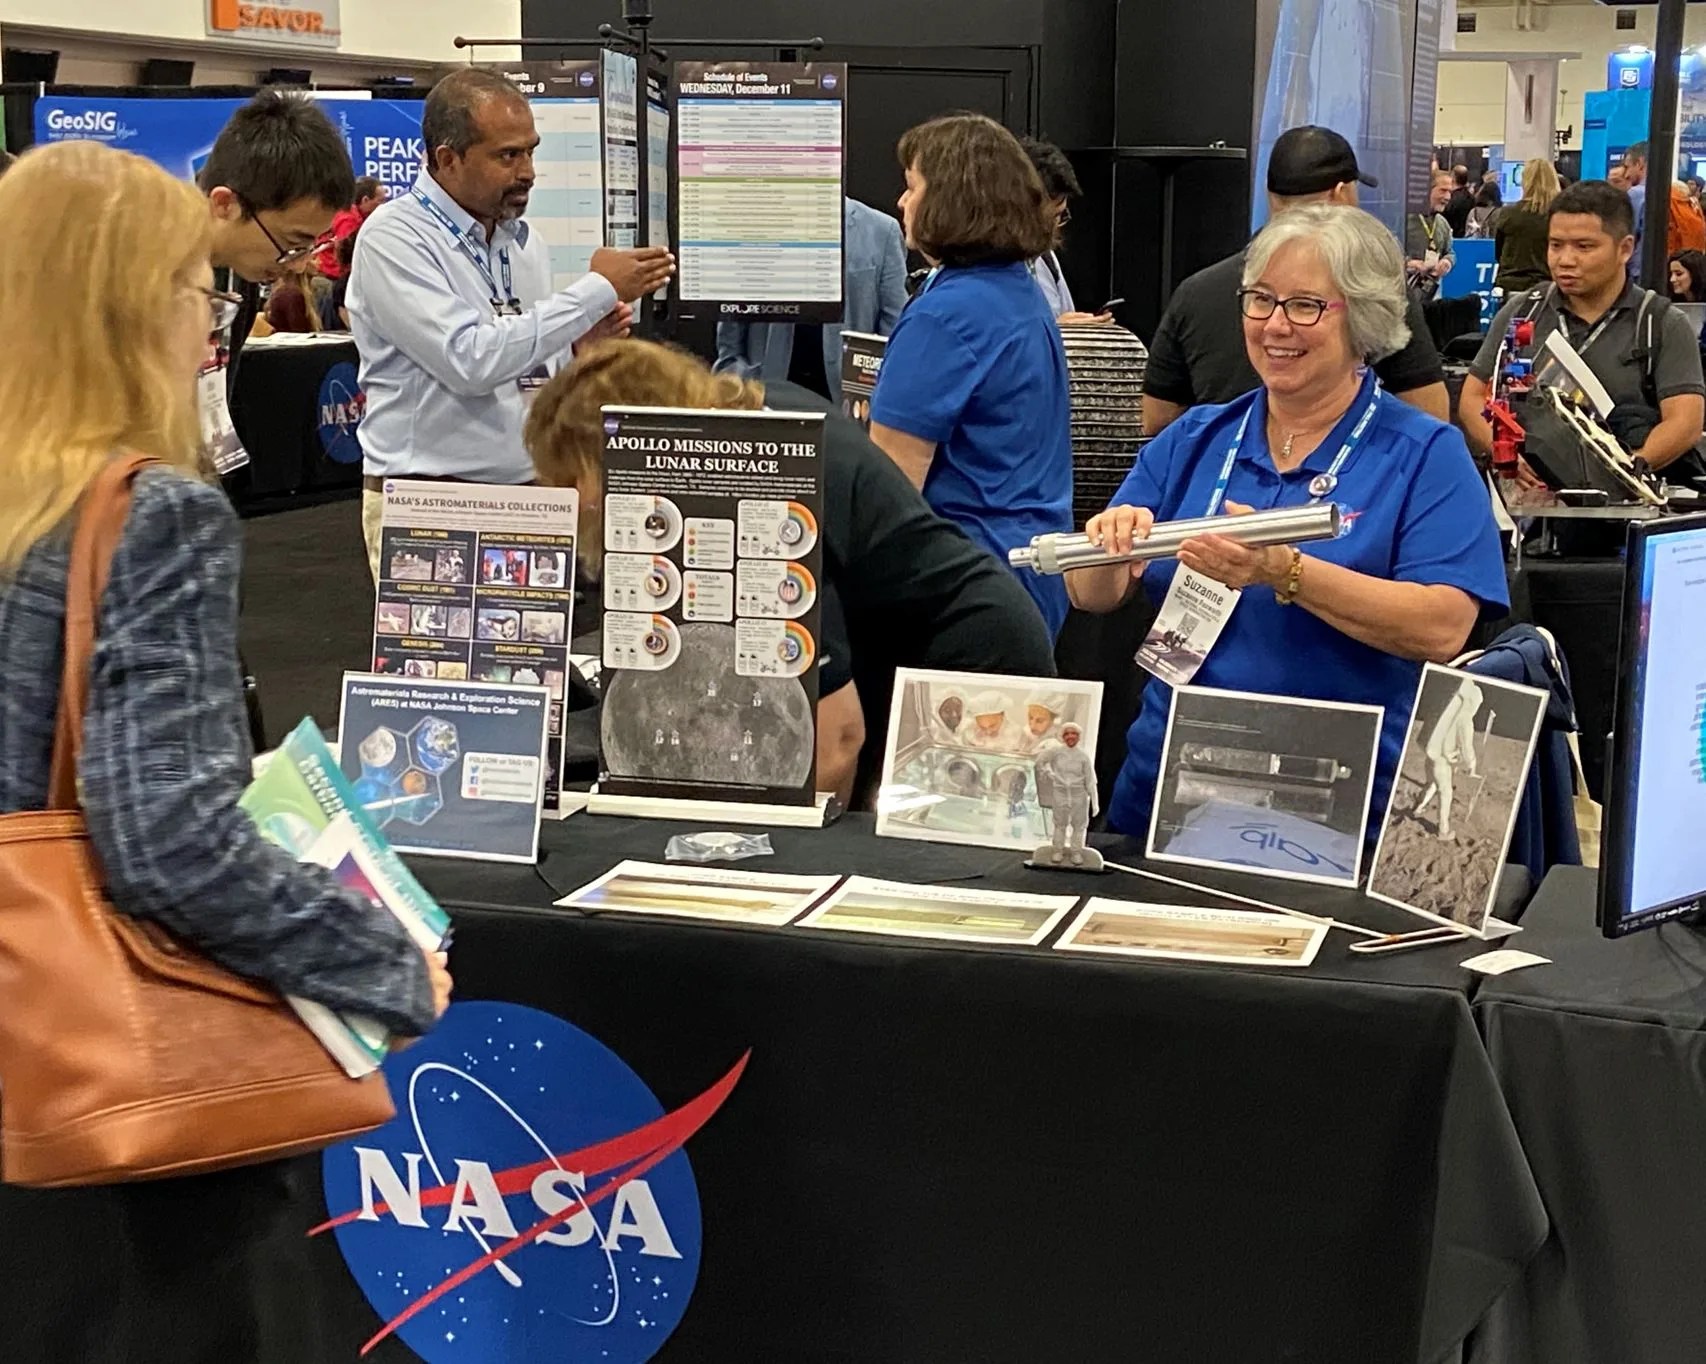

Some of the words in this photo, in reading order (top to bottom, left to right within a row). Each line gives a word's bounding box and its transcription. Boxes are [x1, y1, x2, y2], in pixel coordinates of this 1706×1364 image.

[704, 72, 736, 82] Schedule
[736, 74, 744, 82] of
[744, 73, 768, 82] Events
[538, 82, 545, 93] 9
[680, 83, 735, 95] WEDNESDAY,
[736, 84, 778, 94] December
[780, 84, 790, 95] 11
[48, 109, 117, 131] GeoSIG
[364, 136, 422, 159] PEAK
[366, 160, 419, 182] PERF
[720, 304, 760, 314] EXPLORE
[761, 305, 800, 314] SCIENCE
[606, 436, 670, 451] APOLLO
[674, 438, 753, 454] MISSIONS
[755, 442, 778, 456] TO
[780, 443, 816, 458] THE
[645, 455, 700, 470] LUNAR
[704, 458, 779, 474] SURFACE
[388, 496, 420, 506] NASA'S
[422, 498, 505, 510] ASTROMATERIALS
[507, 503, 572, 513] COLLECTIONS
[1184, 574, 1224, 606] Suzanne
[351, 686, 410, 698] Astromaterials
[412, 690, 450, 700] Research
[451, 692, 458, 700] &
[460, 693, 506, 704] Exploration
[508, 696, 540, 706] Science
[371, 698, 399, 708] (ARES)
[409, 700, 432, 710] NASA
[433, 702, 466, 712] Johnson
[468, 704, 490, 714] Space
[492, 706, 518, 715] Center
[353, 1146, 683, 1259] NASA
